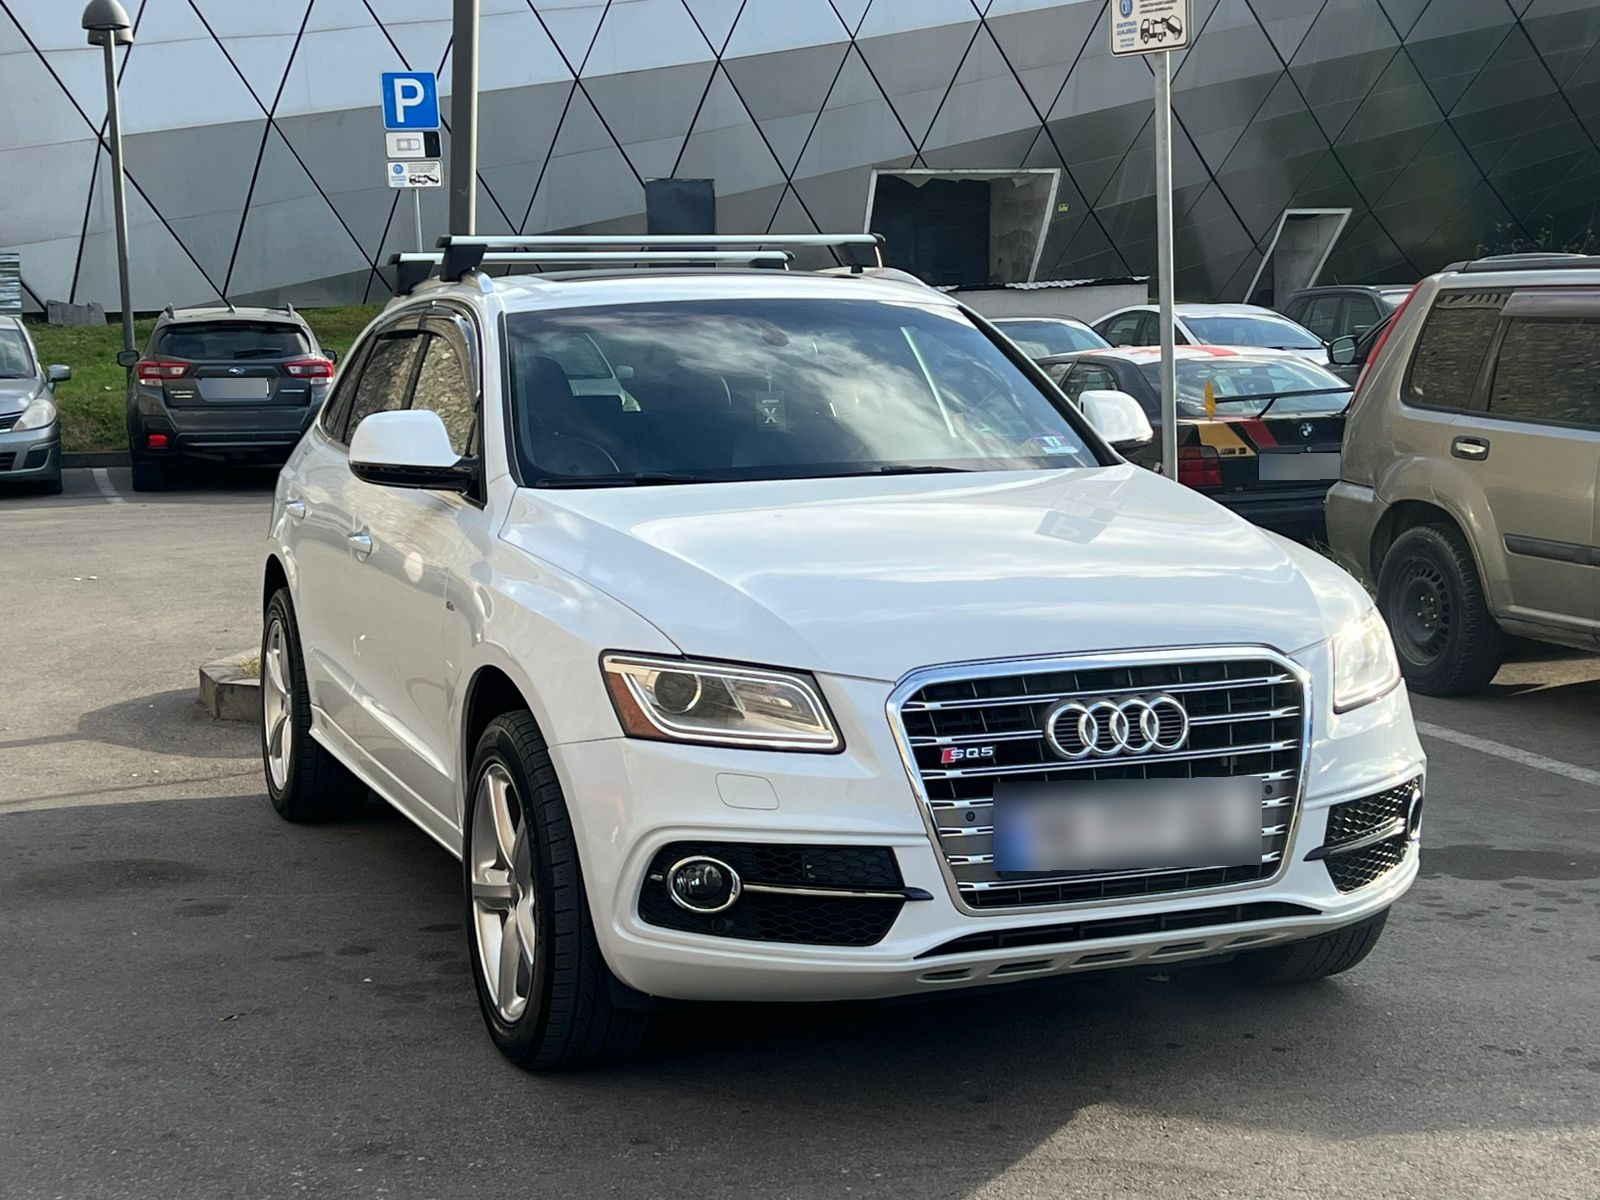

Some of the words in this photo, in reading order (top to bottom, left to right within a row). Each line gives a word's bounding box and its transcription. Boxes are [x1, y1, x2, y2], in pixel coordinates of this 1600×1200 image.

[393, 78, 425, 123] P
[764, 407, 777, 424] X
[949, 745, 994, 760] SQ5
